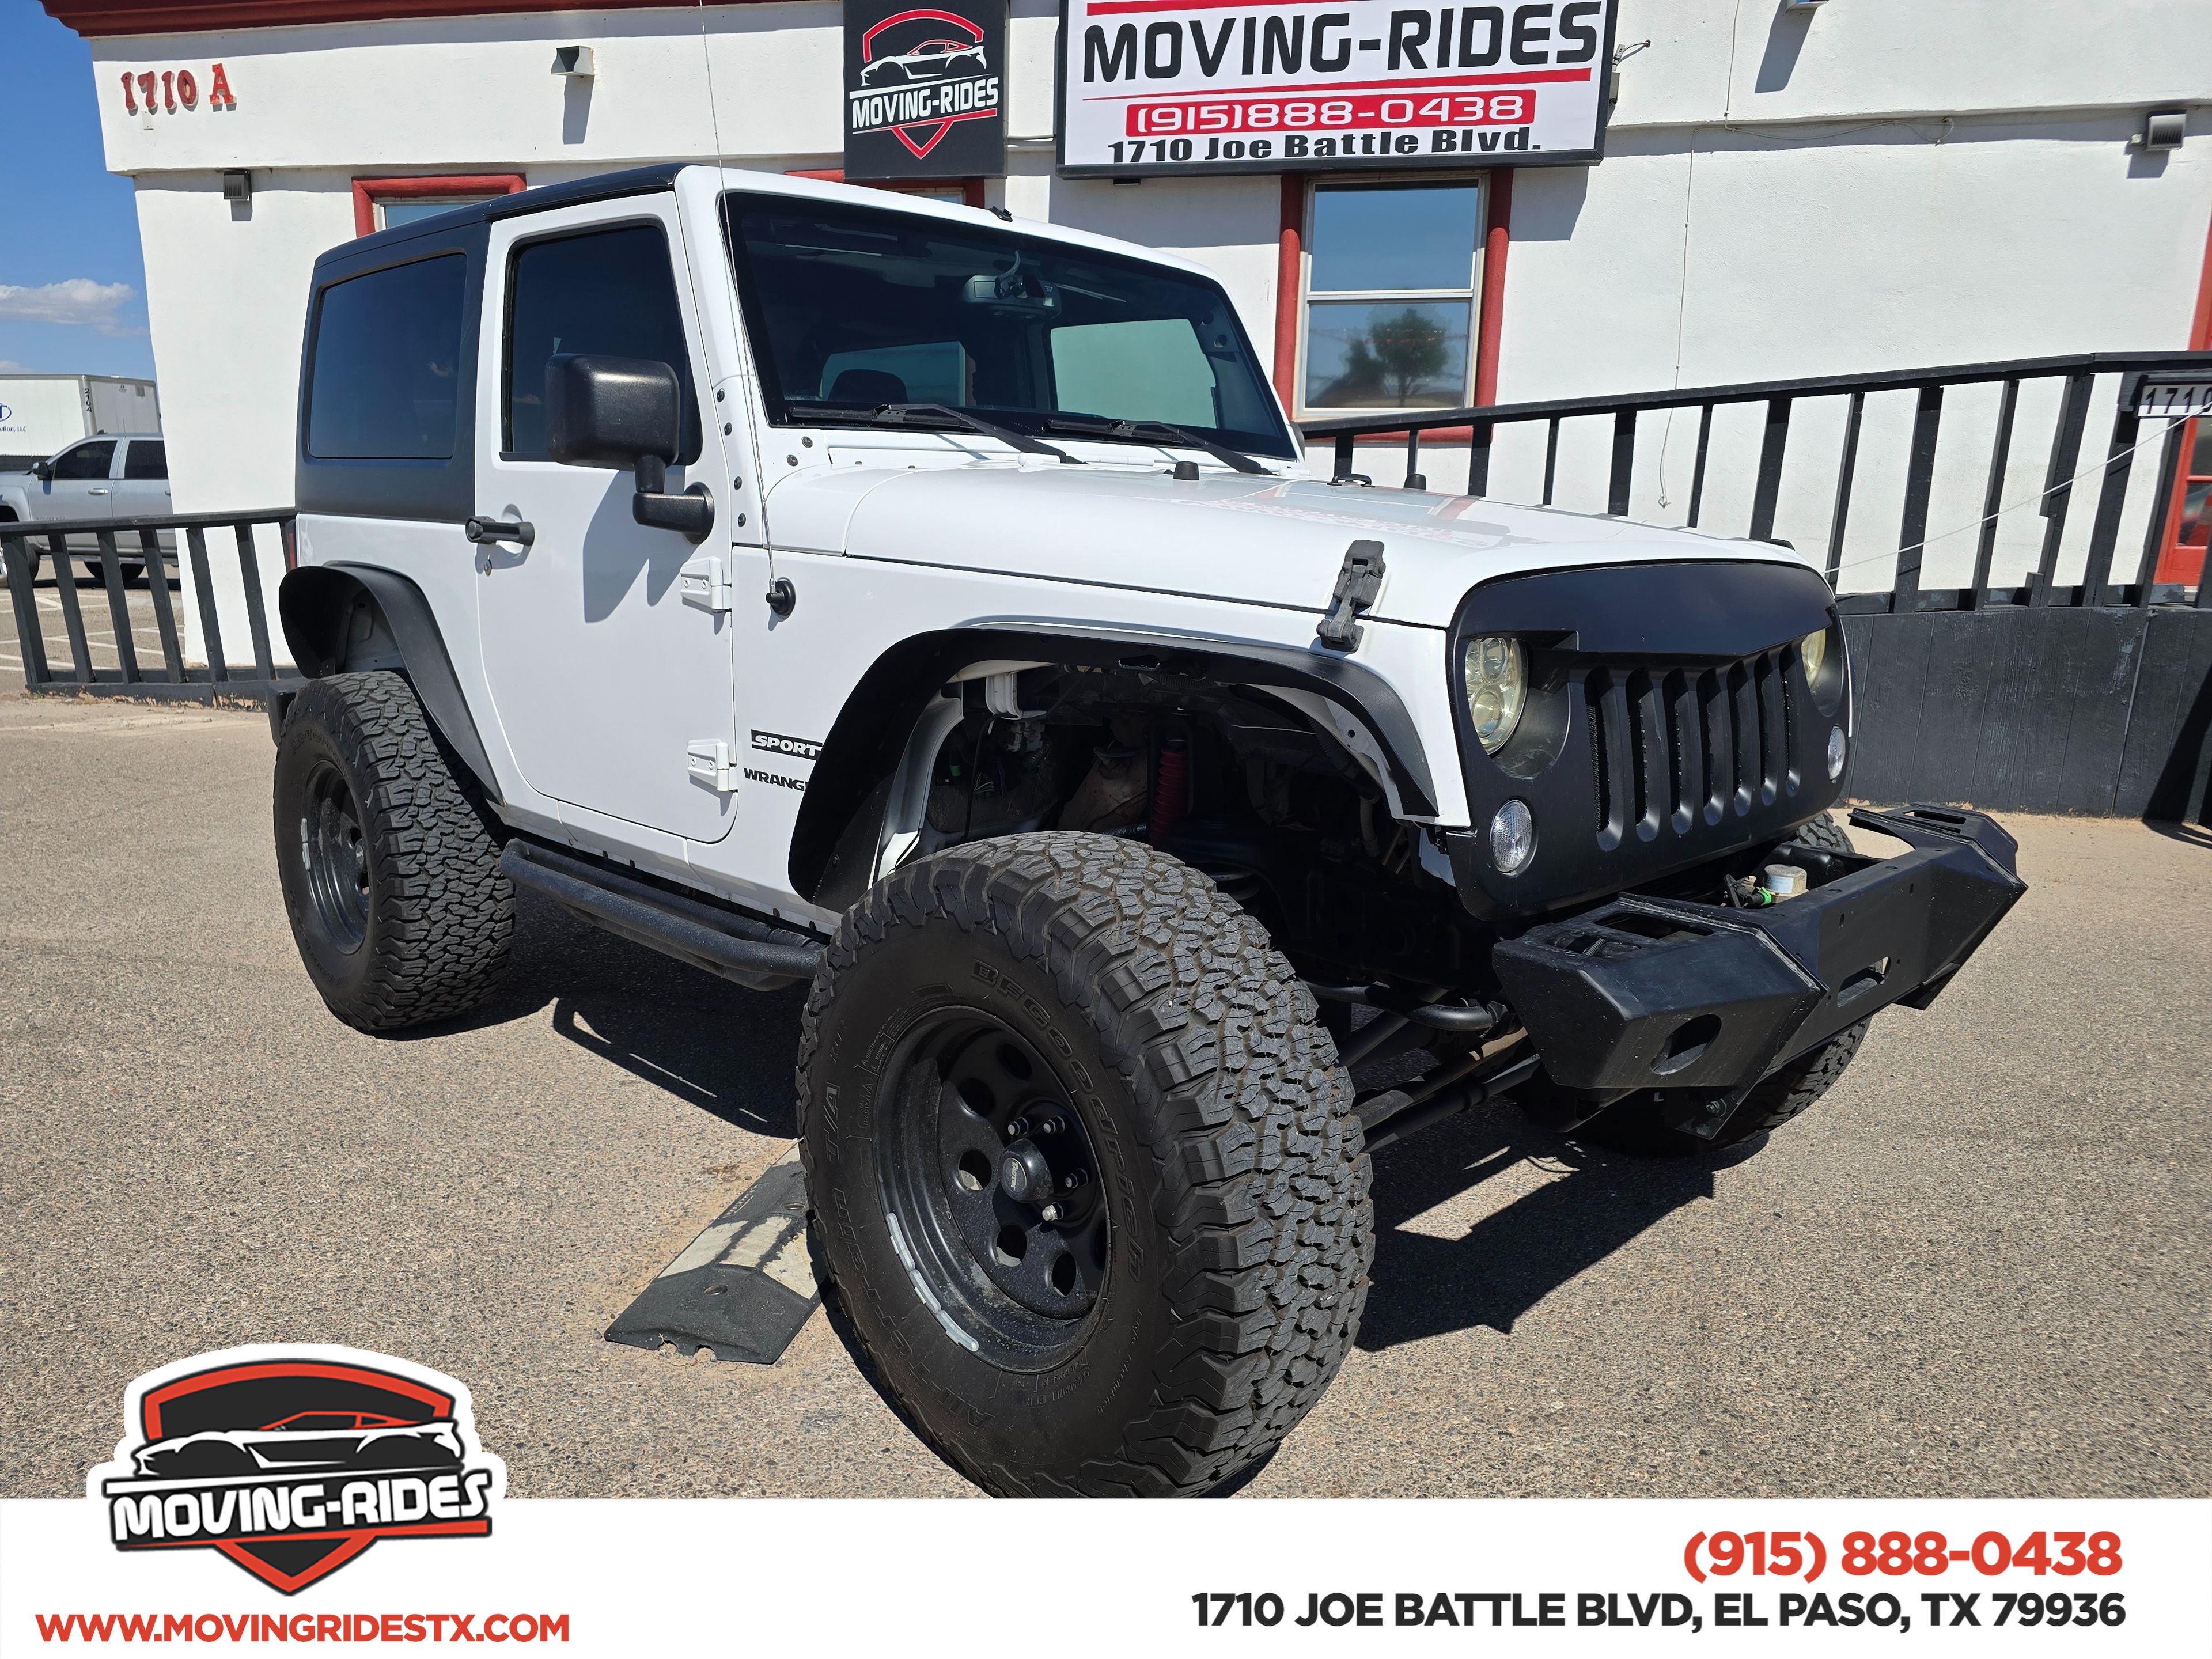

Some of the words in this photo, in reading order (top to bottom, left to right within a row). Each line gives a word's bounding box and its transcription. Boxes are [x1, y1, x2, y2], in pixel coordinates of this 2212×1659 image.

[1084, 1, 1601, 82] MOVING-RIDES
[120, 70, 197, 109] 1710
[209, 63, 234, 104] A
[853, 77, 999, 128] MOVING-RIDES
[1137, 95, 1524, 132] (915)888-0438
[1108, 140, 1192, 164] 1710
[1205, 137, 1272, 160] Joe
[1284, 131, 1418, 158] Battle
[1431, 127, 1541, 153] Blvd.
[2145, 387, 2212, 414] 1710
[751, 734, 823, 757] SPORT
[743, 767, 808, 792] WRANG
